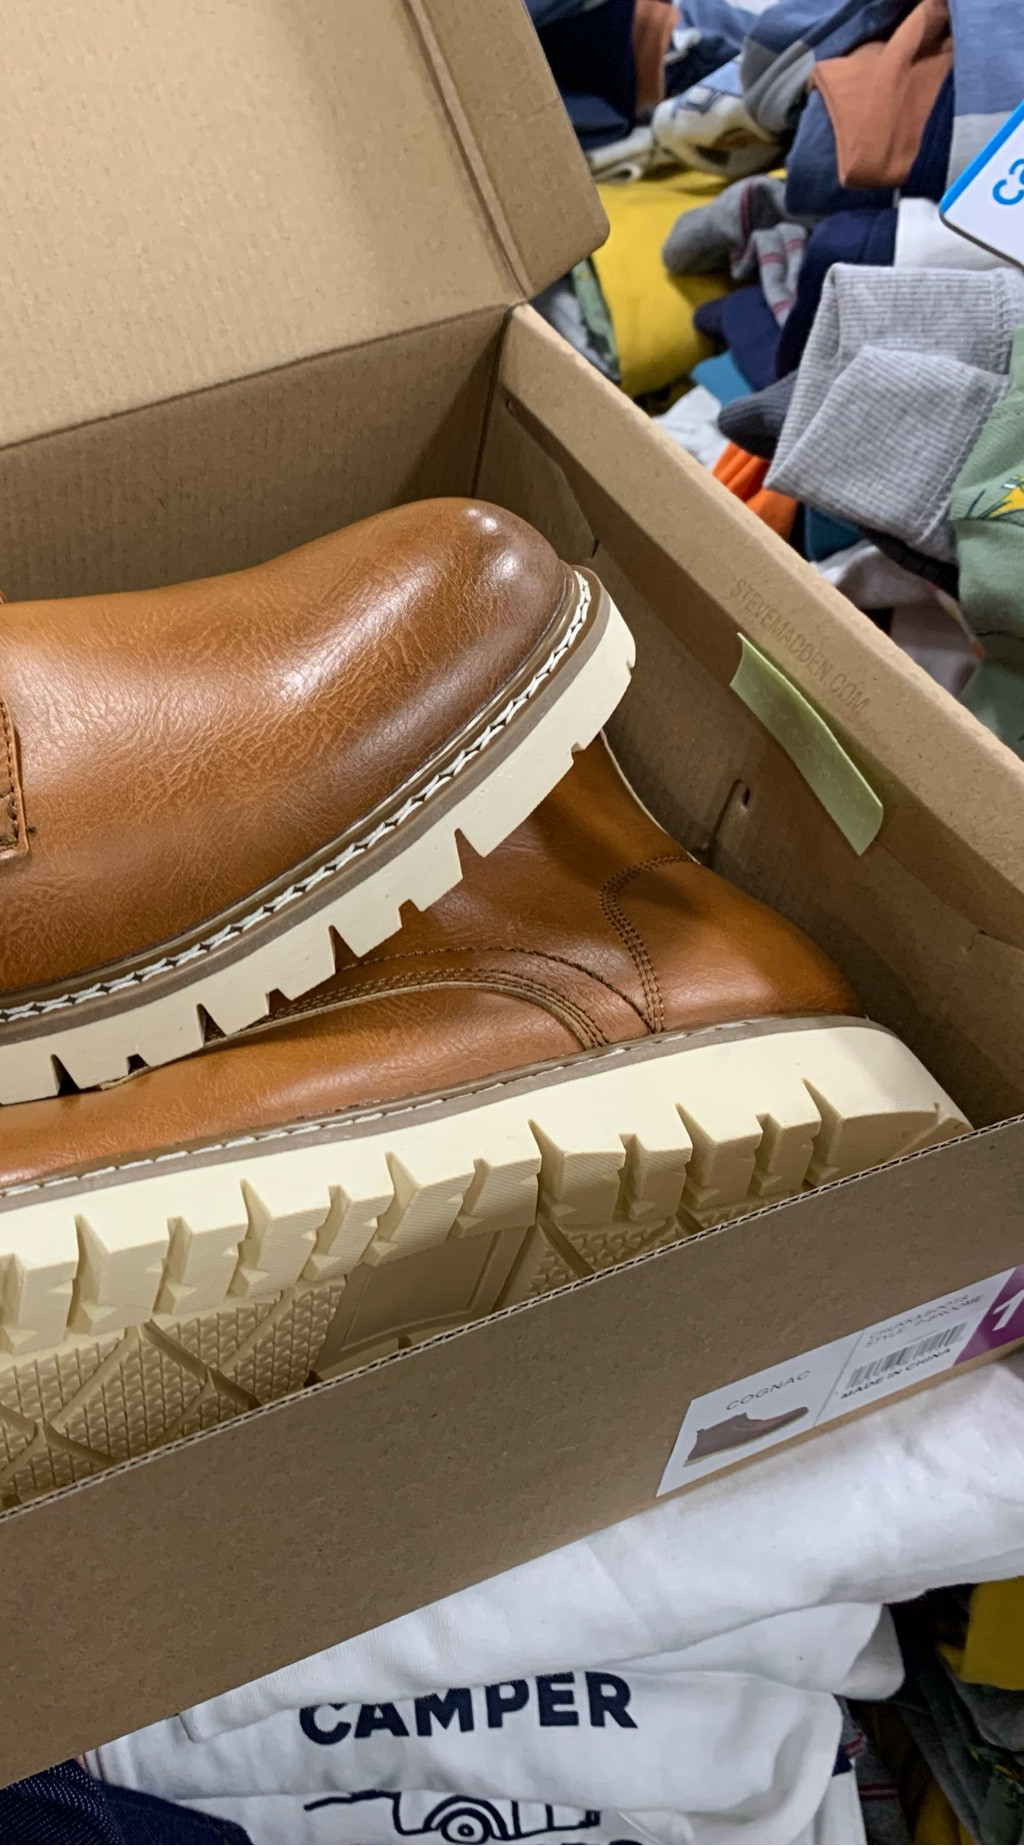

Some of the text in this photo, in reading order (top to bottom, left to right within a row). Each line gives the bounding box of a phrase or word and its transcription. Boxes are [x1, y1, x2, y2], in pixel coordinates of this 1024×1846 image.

[731, 579, 871, 714] STEVEMADDEN.COM
[725, 1369, 811, 1412] COGNAC
[841, 1348, 951, 1399] MADE IN CHINA
[299, 1671, 638, 1745] CAMPER
